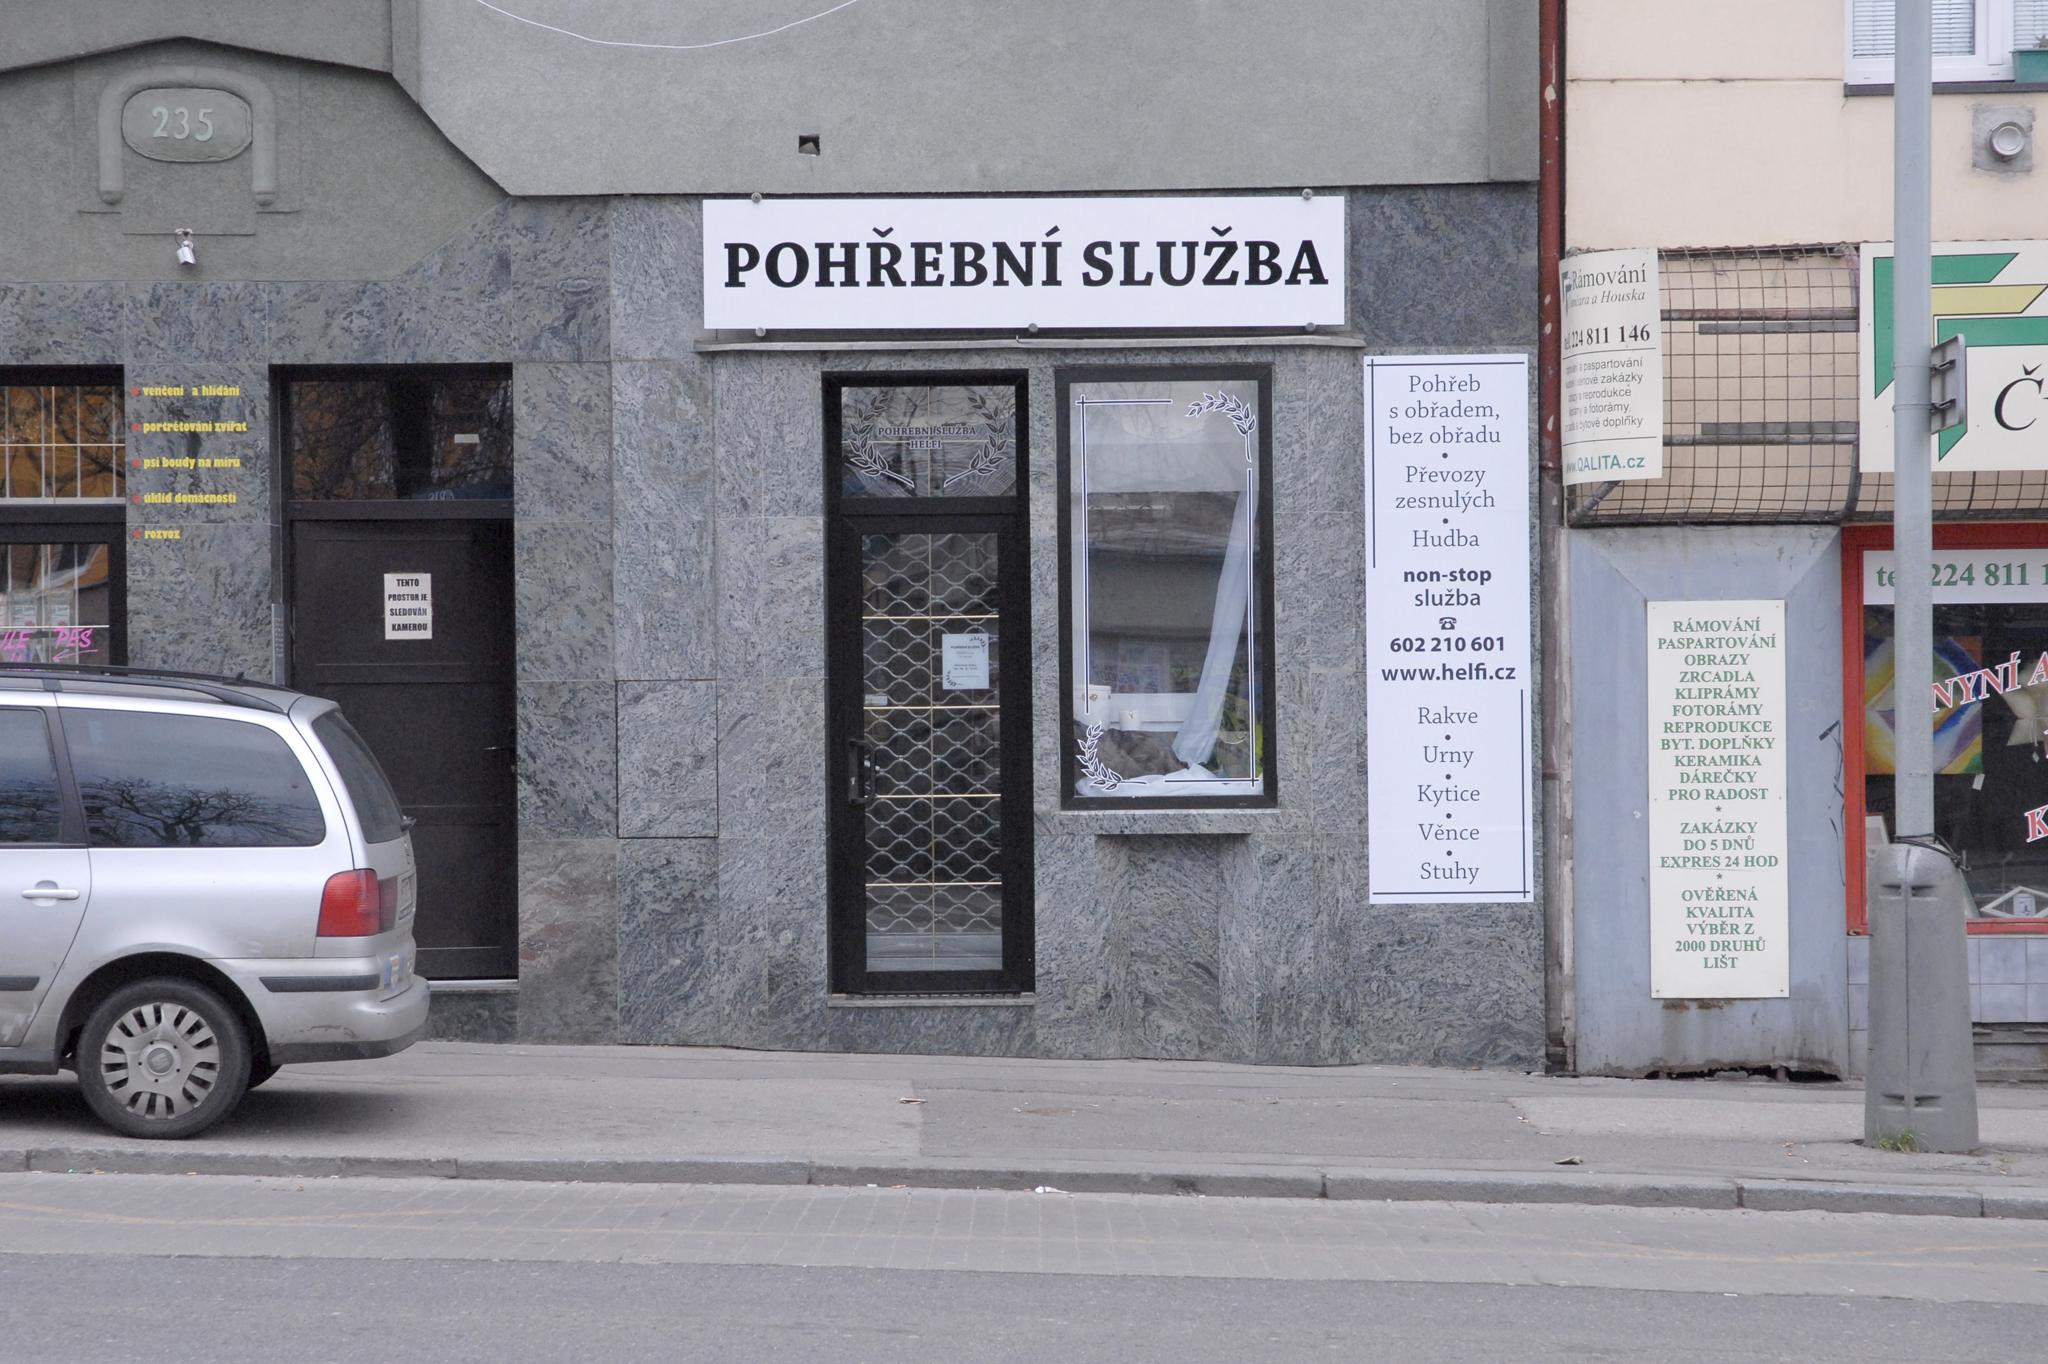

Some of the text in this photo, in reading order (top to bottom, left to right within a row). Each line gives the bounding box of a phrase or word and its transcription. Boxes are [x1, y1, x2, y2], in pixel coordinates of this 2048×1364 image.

[152, 107, 213, 141] 235
[724, 226, 1329, 288] POHŘEBNÍ SLUŽBA
[1572, 263, 1646, 290] Rámování
[1601, 288, 1646, 303] Houska
[1586, 327, 1609, 345] 811
[1619, 324, 1650, 342] 146
[1409, 373, 1481, 393] Pohřeb
[1601, 371, 1643, 384] zakázky
[192, 386, 198, 396] a
[1994, 363, 2048, 431] Č
[1389, 399, 1500, 420] s obřadem,
[1602, 415, 1643, 428] doplňky
[1388, 424, 1501, 445] bez obřadu
[909, 440, 942, 449] HELFI
[162, 457, 196, 469] boudy
[199, 459, 211, 468] na
[1406, 465, 1486, 488] Převozy
[1395, 489, 1496, 514] zesnulých
[144, 530, 181, 539] rozvoz
[1412, 528, 1480, 548] Hudba
[396, 578, 420, 587] TENTO
[1403, 567, 1492, 586] non-stop
[1984, 562, 2029, 586] 811
[1414, 588, 1481, 607] služba
[391, 623, 428, 631] KAMEROU
[1673, 616, 1760, 633] RÁMOVÁNÍ
[1390, 636, 1504, 653] 602 210 601
[1658, 633, 1776, 650] PASPARTOVÁNÍ
[1684, 653, 1750, 666] OBRAZY
[1381, 662, 1516, 682] www.helfi.cz
[1679, 670, 1756, 683] ZRCADLA
[1931, 651, 2021, 713] NYNÍ
[1675, 684, 1760, 700] KLIPRÁMY
[1418, 705, 1478, 725] Rakve
[1672, 700, 1763, 717] FOTORÁMY
[1663, 720, 1773, 734] REPRODUKCE
[1661, 735, 1775, 751] BYT. DOPLŇKY
[1423, 745, 1474, 769] Urny
[1674, 754, 1762, 767] KERAMIKA
[1679, 768, 1757, 784] DÁREČKY
[1417, 784, 1481, 808] Kytice
[1669, 788, 1769, 801] PRO RADOST
[1418, 822, 1480, 842] Věnce
[1680, 818, 1758, 834] ZAKÁZKY
[1683, 834, 1755, 851] DO 5 DNŮ
[1660, 855, 1779, 869] EXPRES 24 HOD
[1420, 860, 1480, 885] Stuhy
[1681, 886, 1758, 902] OVĚŘENÁ
[1686, 906, 1754, 919] KVALITA
[1687, 920, 1755, 935] VÝBĚR Z
[1675, 936, 1766, 952] 2000 DRUHŮ
[1703, 953, 1739, 969] LIŠT
